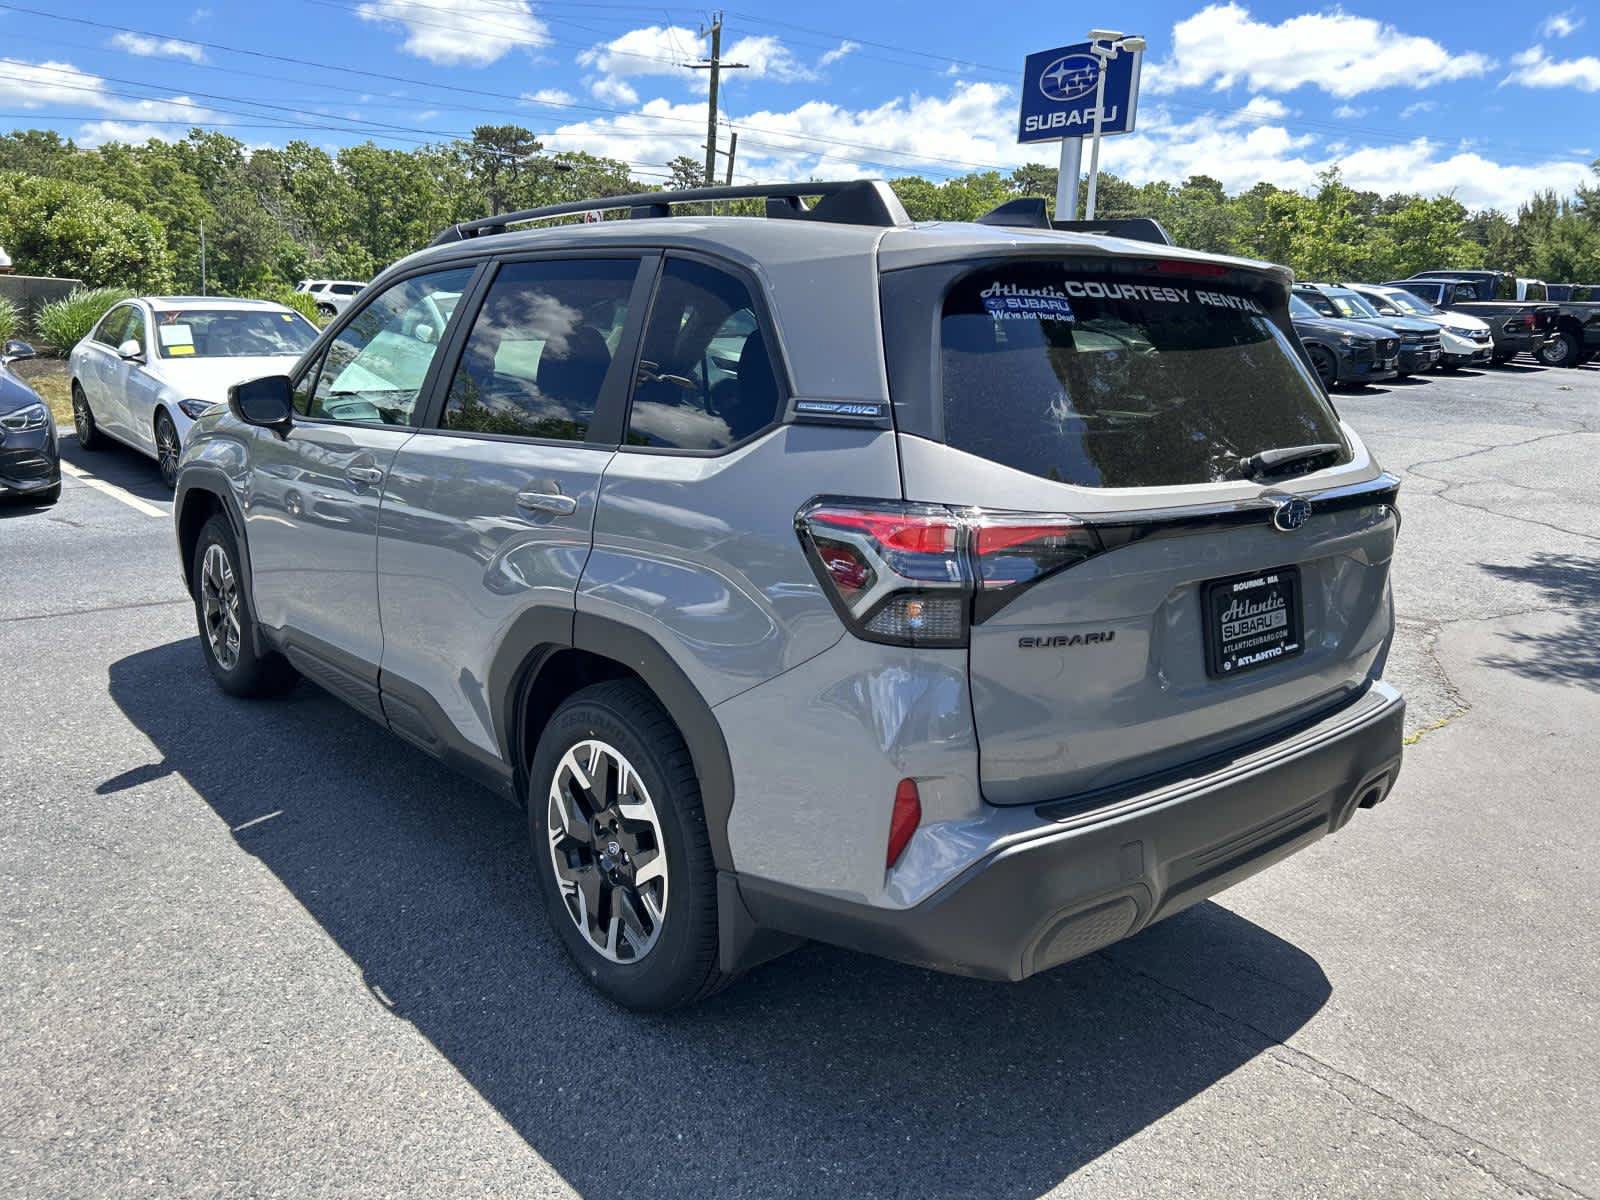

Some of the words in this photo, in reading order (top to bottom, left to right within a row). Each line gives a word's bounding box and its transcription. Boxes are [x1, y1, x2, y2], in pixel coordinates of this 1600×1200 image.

[1025, 105, 1118, 132] SUBARU
[980, 281, 1068, 300] Atlantic
[1065, 281, 1189, 302] COURTESY
[1195, 290, 1264, 314] RENTAL
[989, 310, 1021, 320] We've
[1022, 311, 1037, 320] Got
[1037, 312, 1055, 320] Your
[1006, 299, 1070, 311] SUBARU
[1267, 576, 1279, 584] MA
[1222, 592, 1286, 623] Atlantic
[1223, 614, 1273, 640] SUBARU
[1019, 631, 1115, 648] SUBARU
[1223, 629, 1288, 654] ATLANTICSUBARU.COM
[1237, 647, 1282, 667] ATLANTIC
